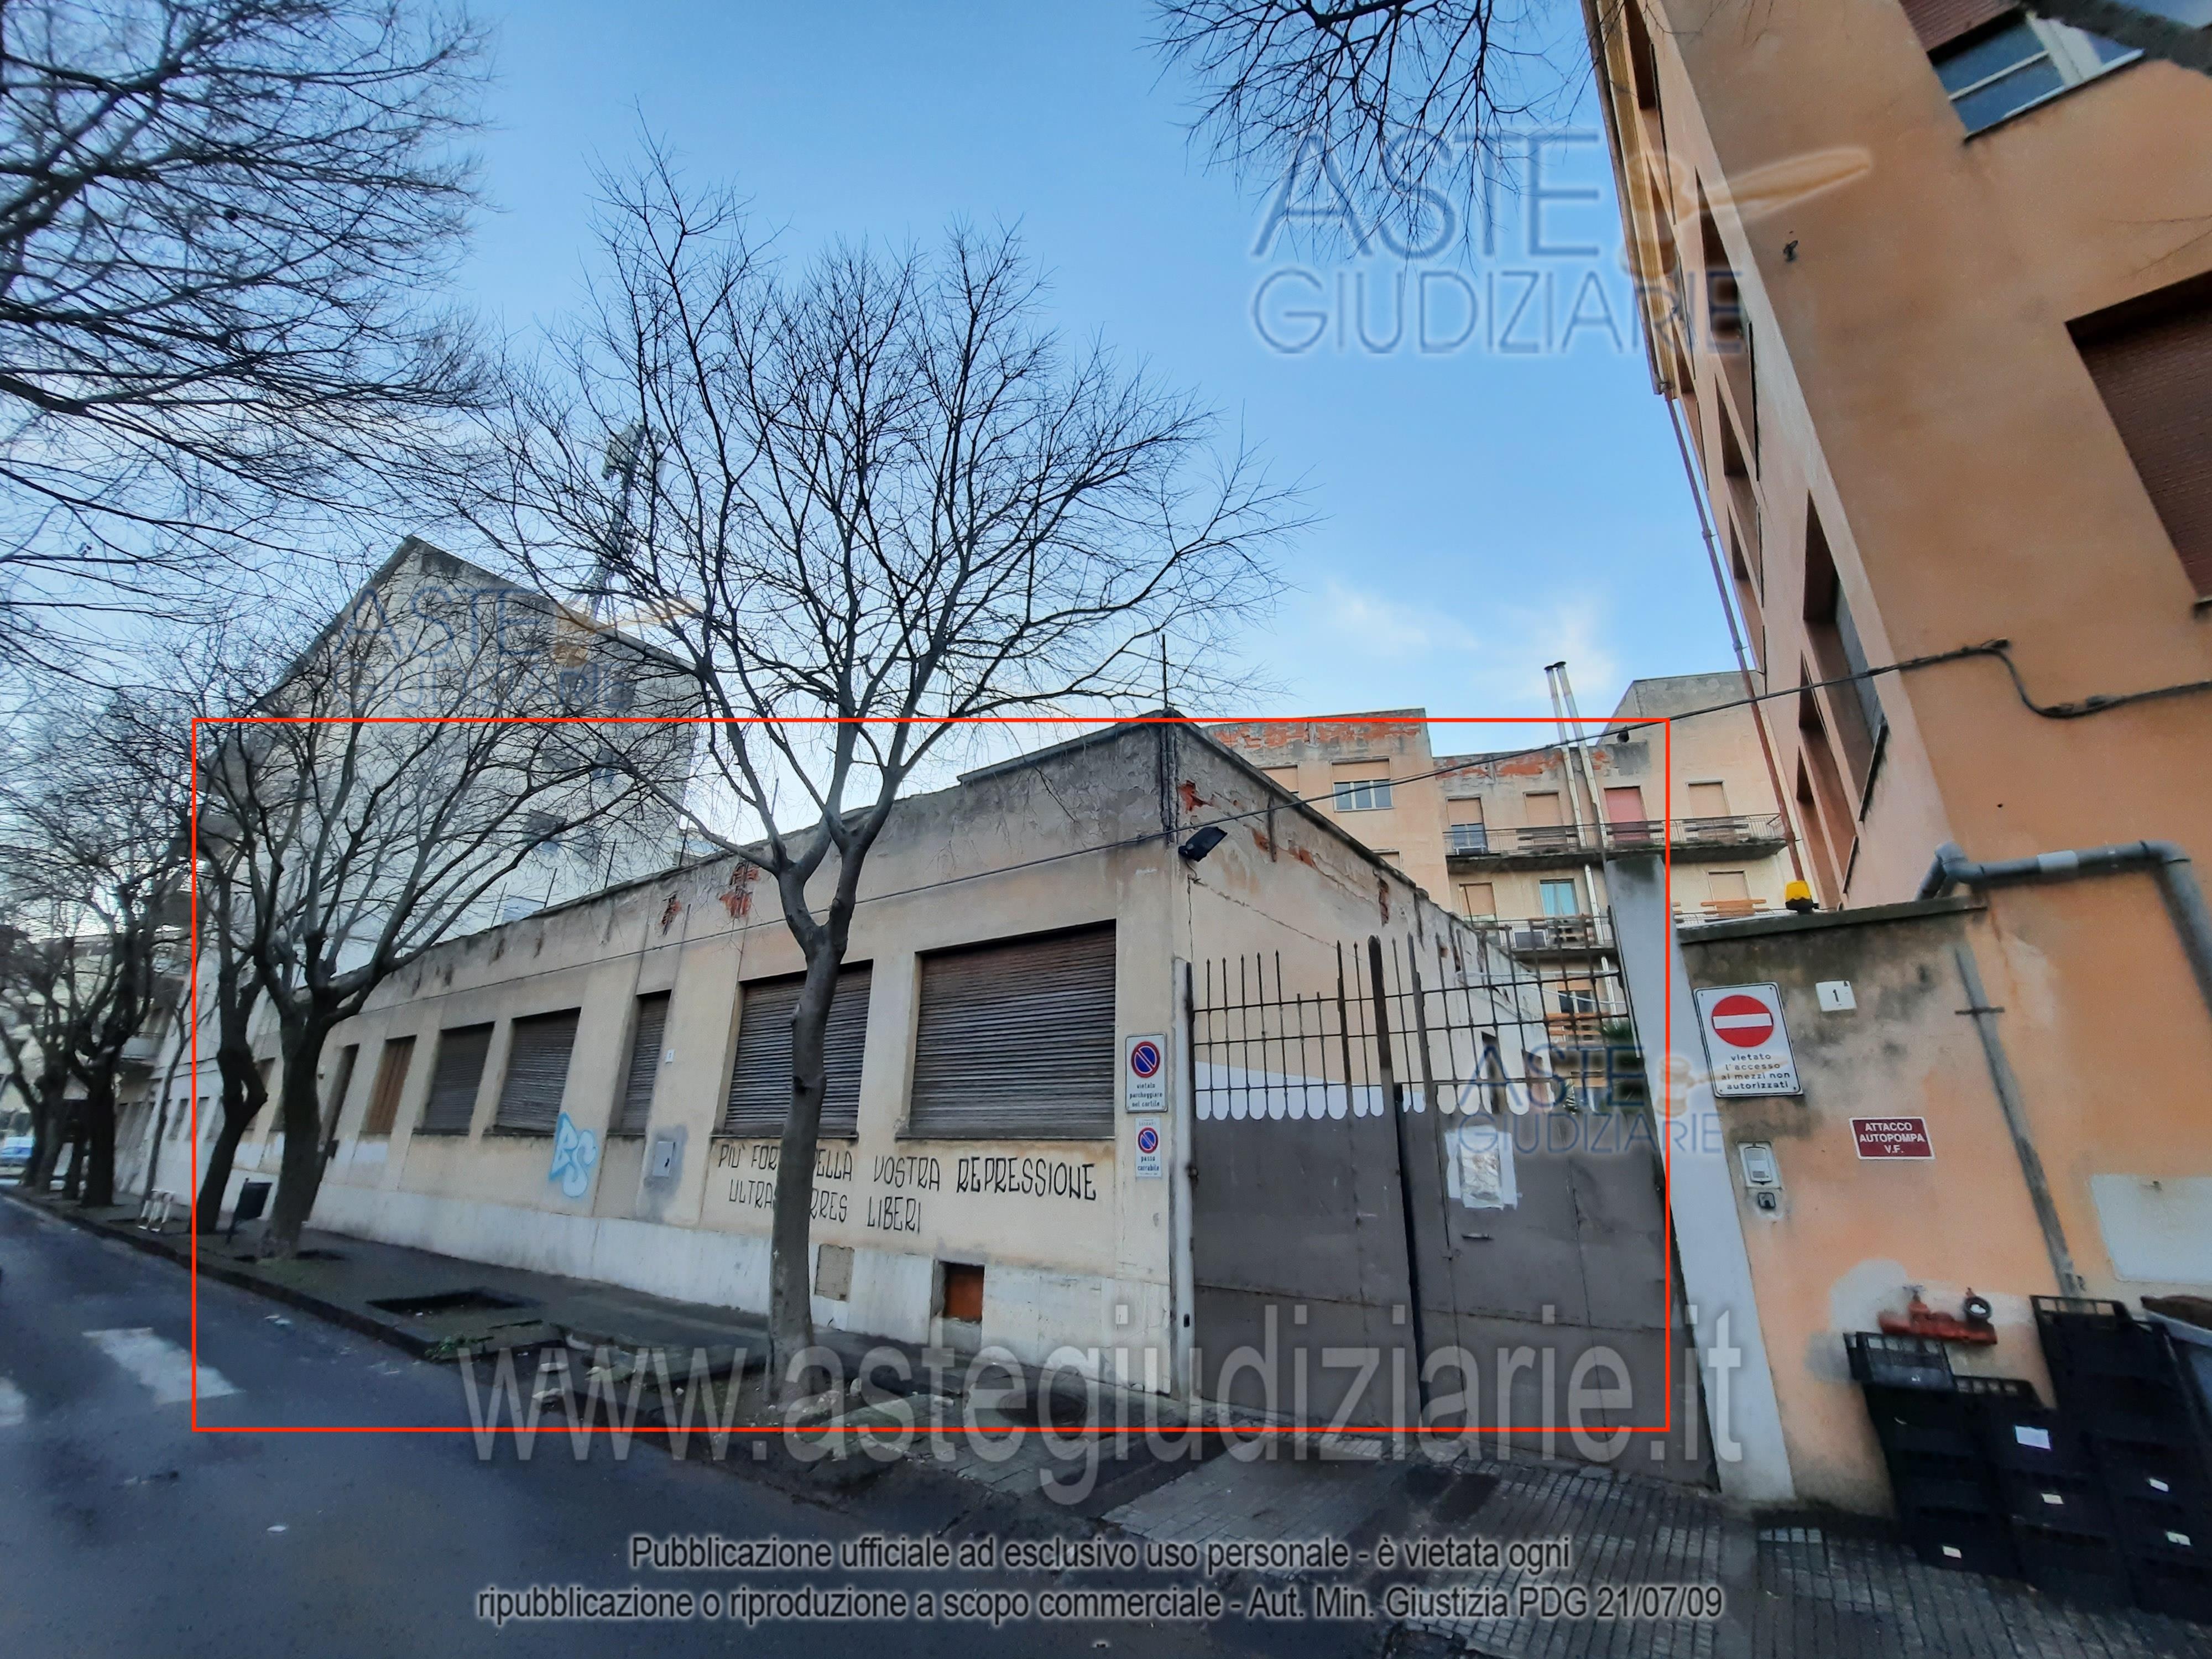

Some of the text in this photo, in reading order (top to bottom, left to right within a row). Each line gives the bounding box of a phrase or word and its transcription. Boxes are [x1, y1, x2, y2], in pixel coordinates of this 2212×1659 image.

[1833, 989, 1839, 1003] 1
[1727, 1081, 1788, 1089] autorizzati
[1129, 1091, 1162, 1100] parcheggiare
[1865, 1122, 1913, 1131] ATTACCO
[1859, 1133, 1926, 1142] AUTOPOMPA
[1884, 1145, 1905, 1154] V.F.
[751, 1145, 779, 1171] FOR
[873, 1155, 940, 1192] VOSTRA
[956, 1156, 1097, 1201] REPRESSIONE
[728, 1179, 921, 1234] ULTRA RRES LIBERI
